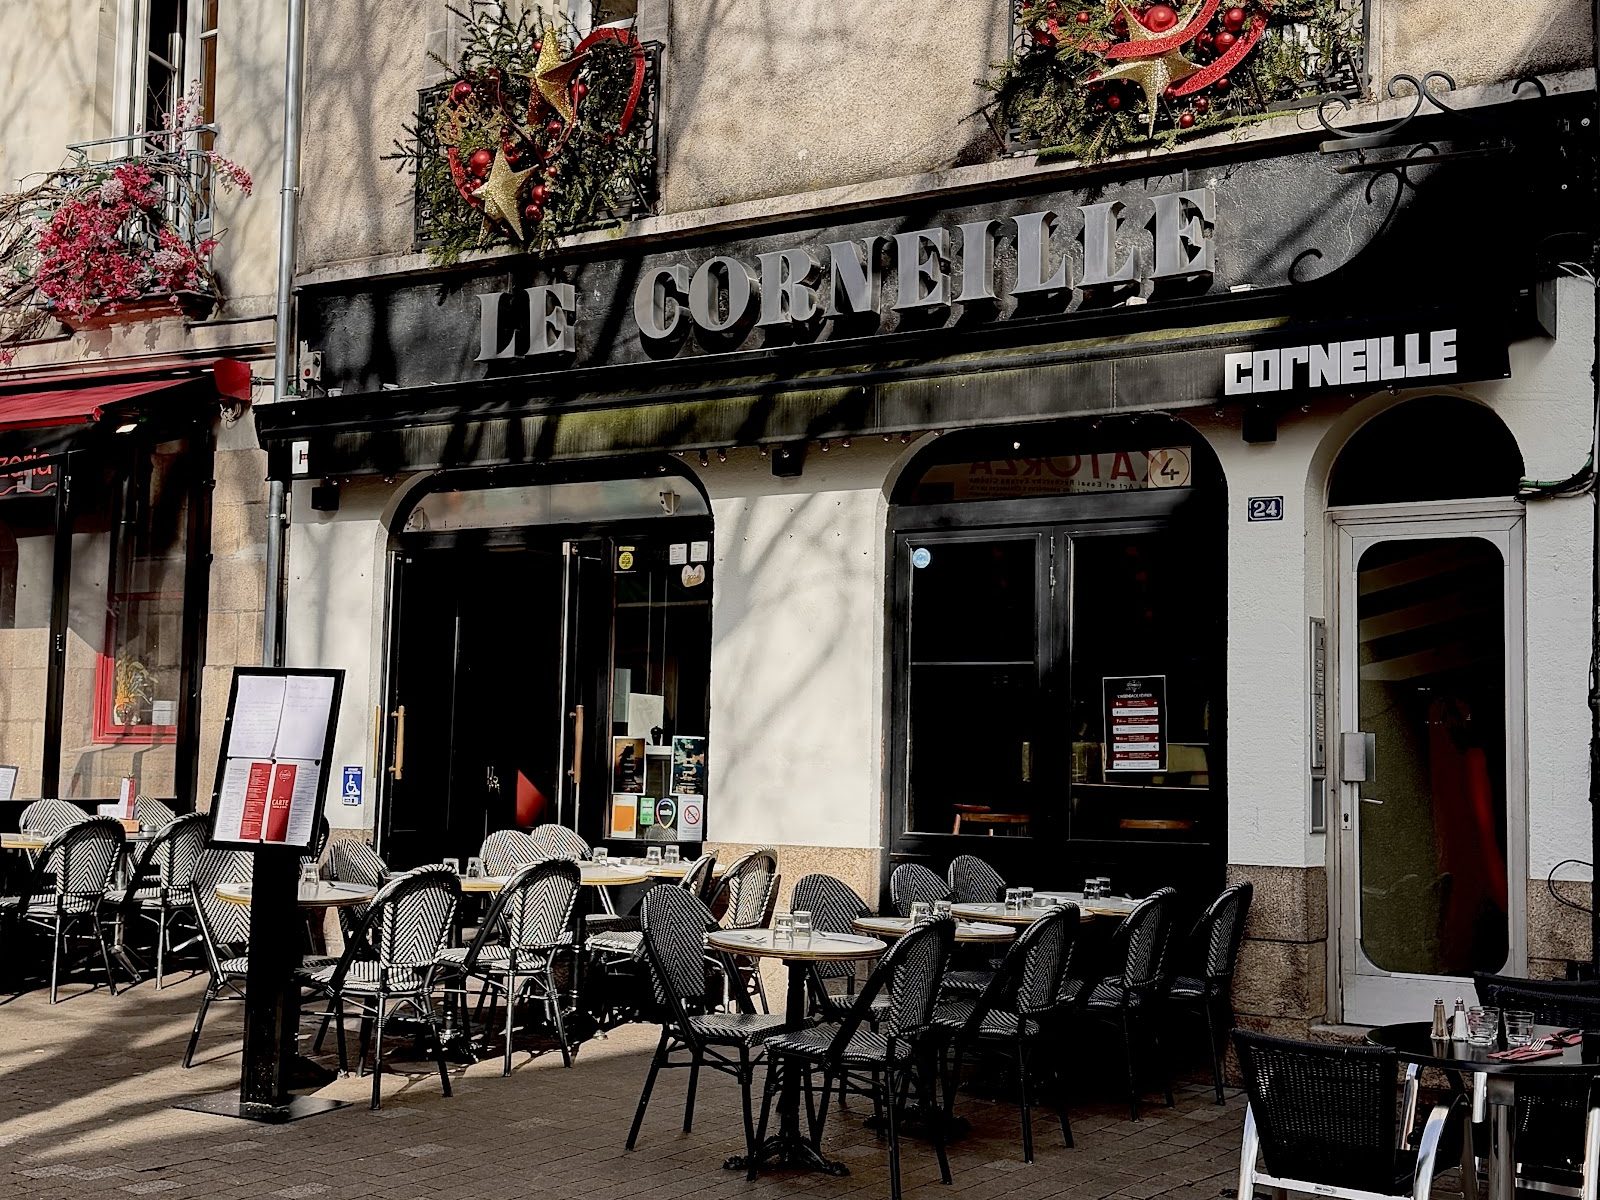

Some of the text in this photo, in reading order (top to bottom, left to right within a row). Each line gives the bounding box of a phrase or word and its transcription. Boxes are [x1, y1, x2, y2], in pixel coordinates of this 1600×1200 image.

[473, 187, 1217, 363] LE CORNEILLE
[1252, 500, 1278, 518] 24
[271, 799, 289, 807] CARTE
